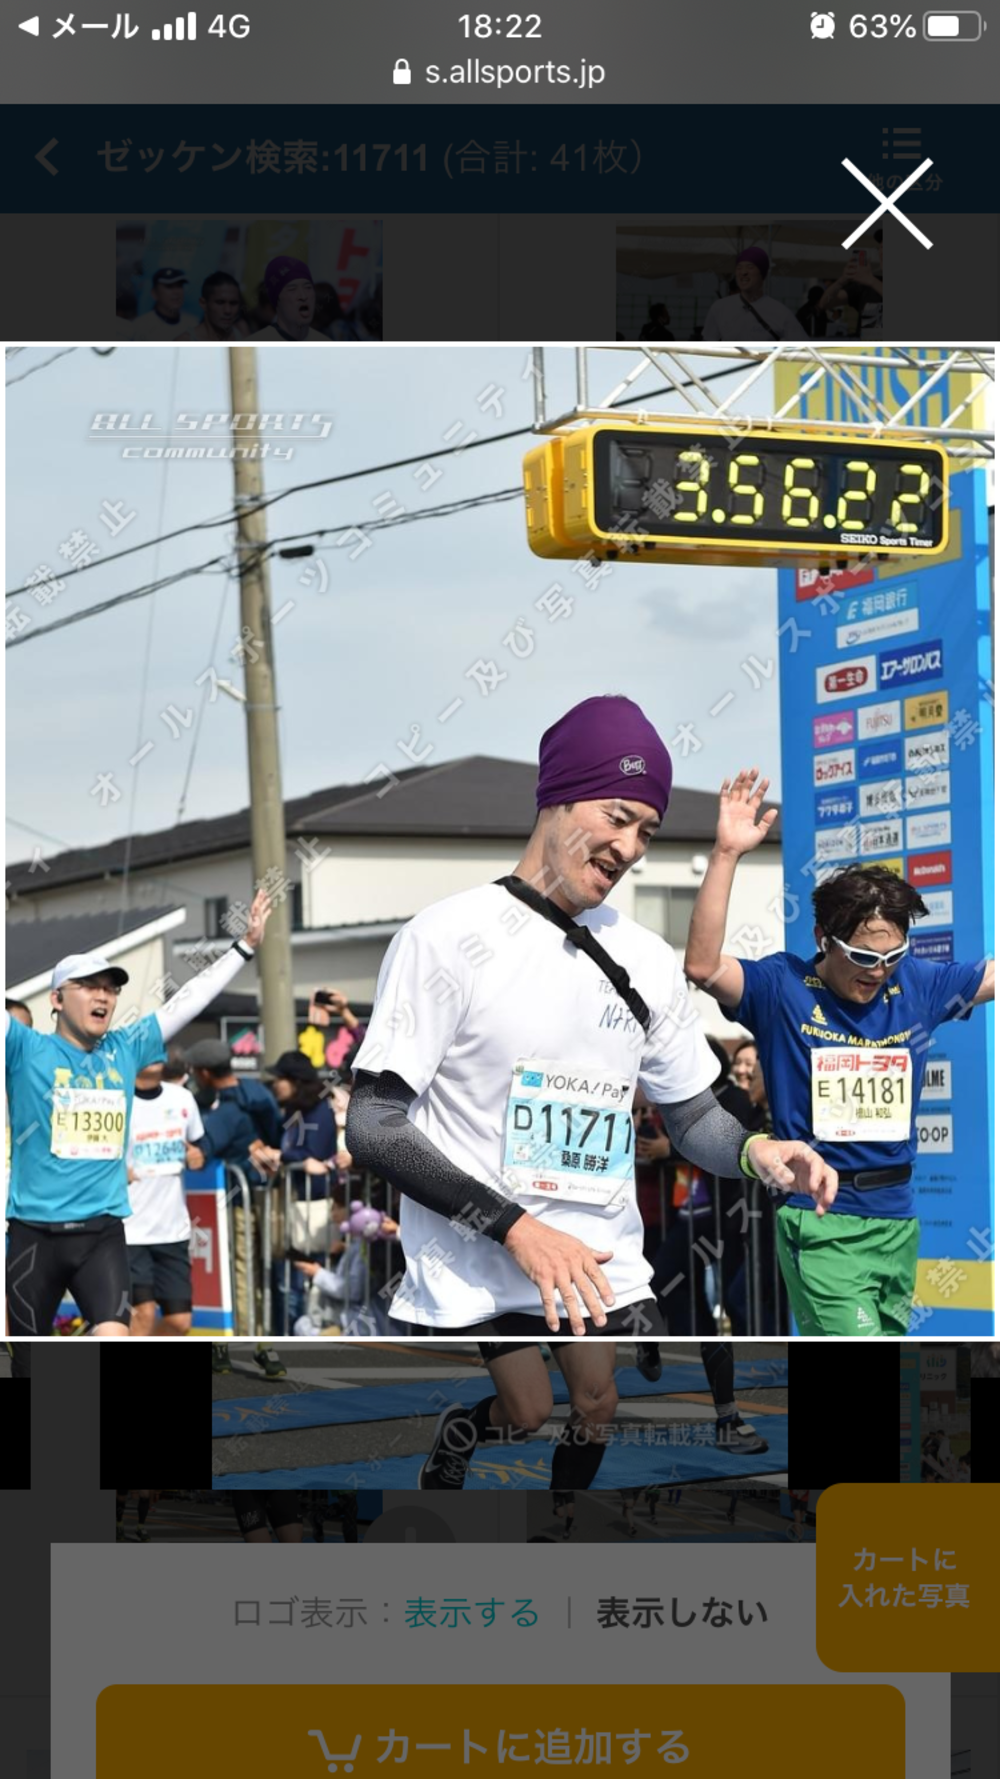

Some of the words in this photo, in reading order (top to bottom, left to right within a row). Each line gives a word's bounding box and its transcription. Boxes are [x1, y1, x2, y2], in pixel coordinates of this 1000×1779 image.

[52, 13, 139, 39] メール
[208, 14, 251, 38] 4G
[459, 14, 541, 38] 18:22
[849, 14, 916, 38] 63%
[426, 59, 605, 88] s.allsports.jp
[840, 533, 877, 545] SEIKO
[879, 535, 908, 546] Sports
[909, 537, 934, 548] Timer
[801, 1023, 847, 1043] FUKUOKA
[817, 1054, 908, 1073] 福岡トヨタ
[561, 1150, 582, 1169] 桑原
[583, 1154, 610, 1173] 勝洋
[853, 1546, 957, 1572] カートに
[838, 1582, 971, 1609] 入れた写真
[404, 1596, 539, 1629] 表示する
[597, 1596, 768, 1629] 表示しない
[376, 1727, 690, 1766] カートに追加する
